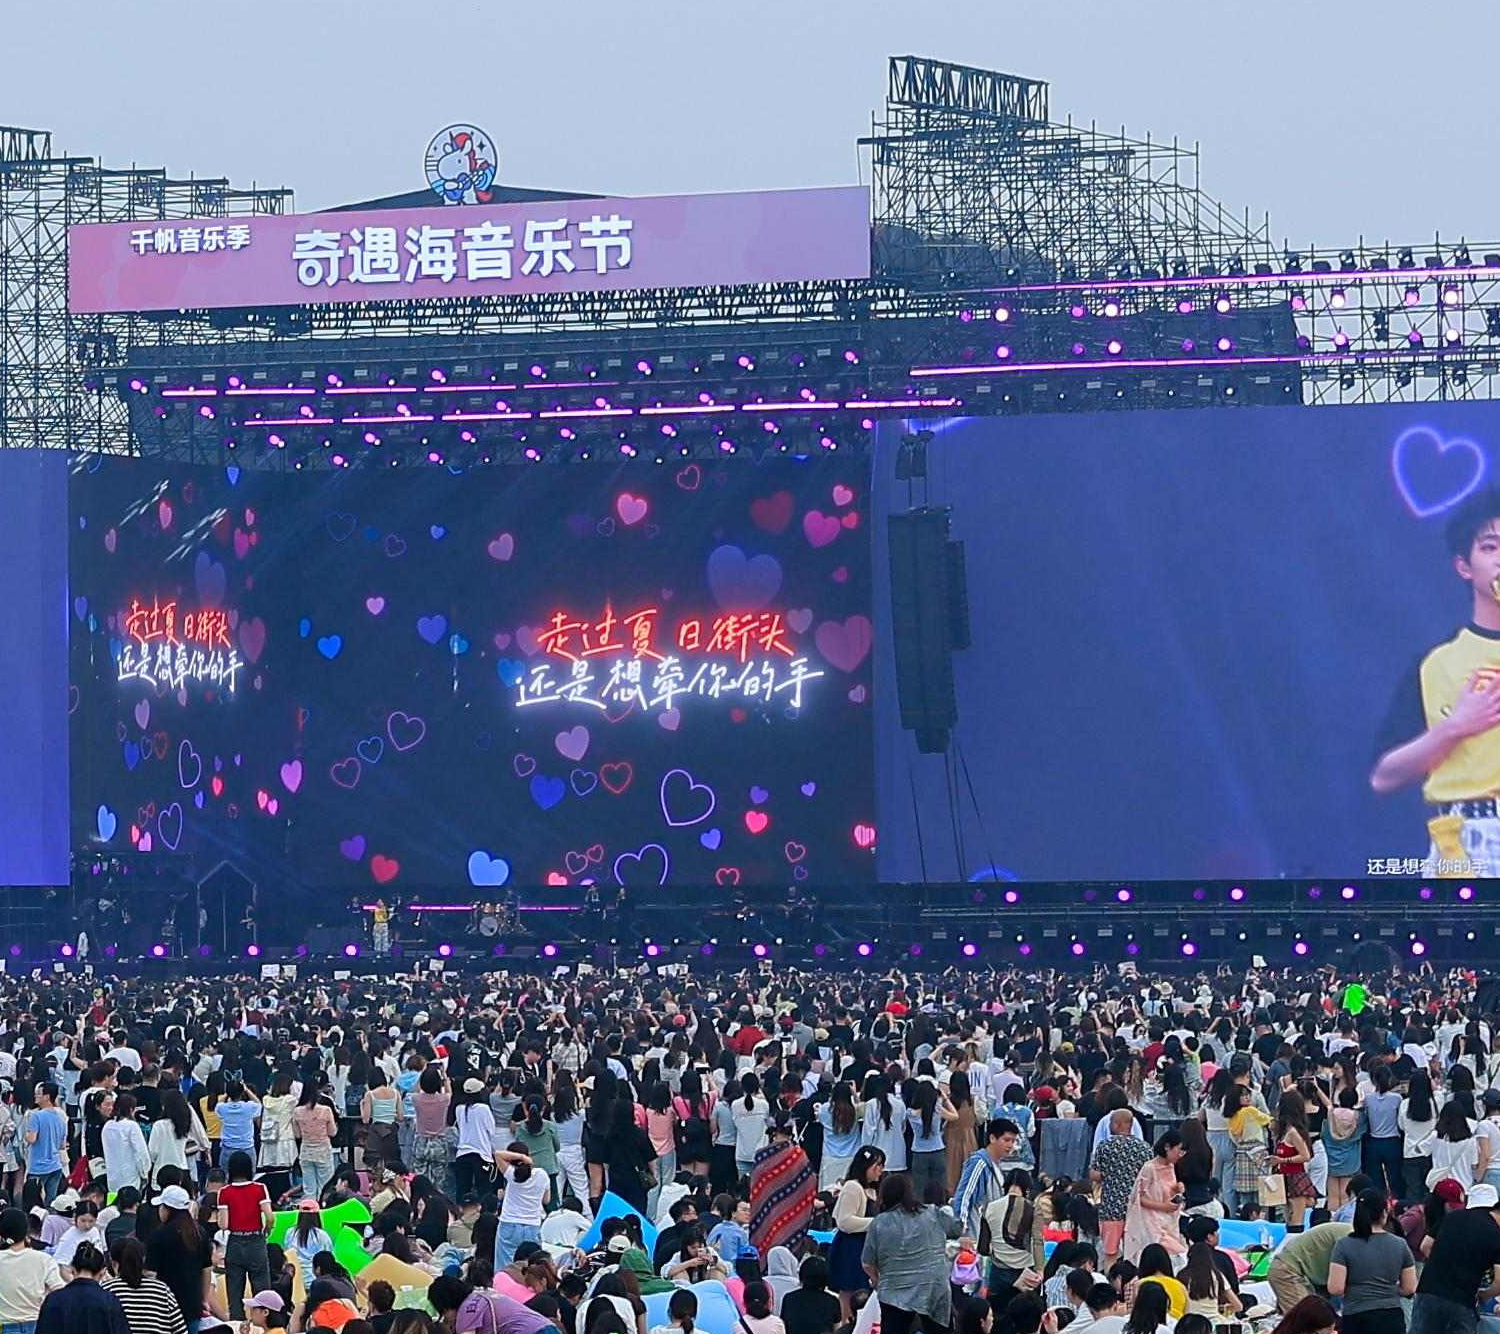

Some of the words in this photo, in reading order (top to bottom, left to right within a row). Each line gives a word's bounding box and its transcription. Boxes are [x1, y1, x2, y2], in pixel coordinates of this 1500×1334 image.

[130, 224, 252, 255] 千帆音乐季
[291, 214, 634, 288] 奇遇海音乐节
[116, 642, 244, 693] 还是想牵你的手
[514, 655, 825, 711] 还是想牵你的手
[1366, 857, 1487, 875] 还是想牵你的手
